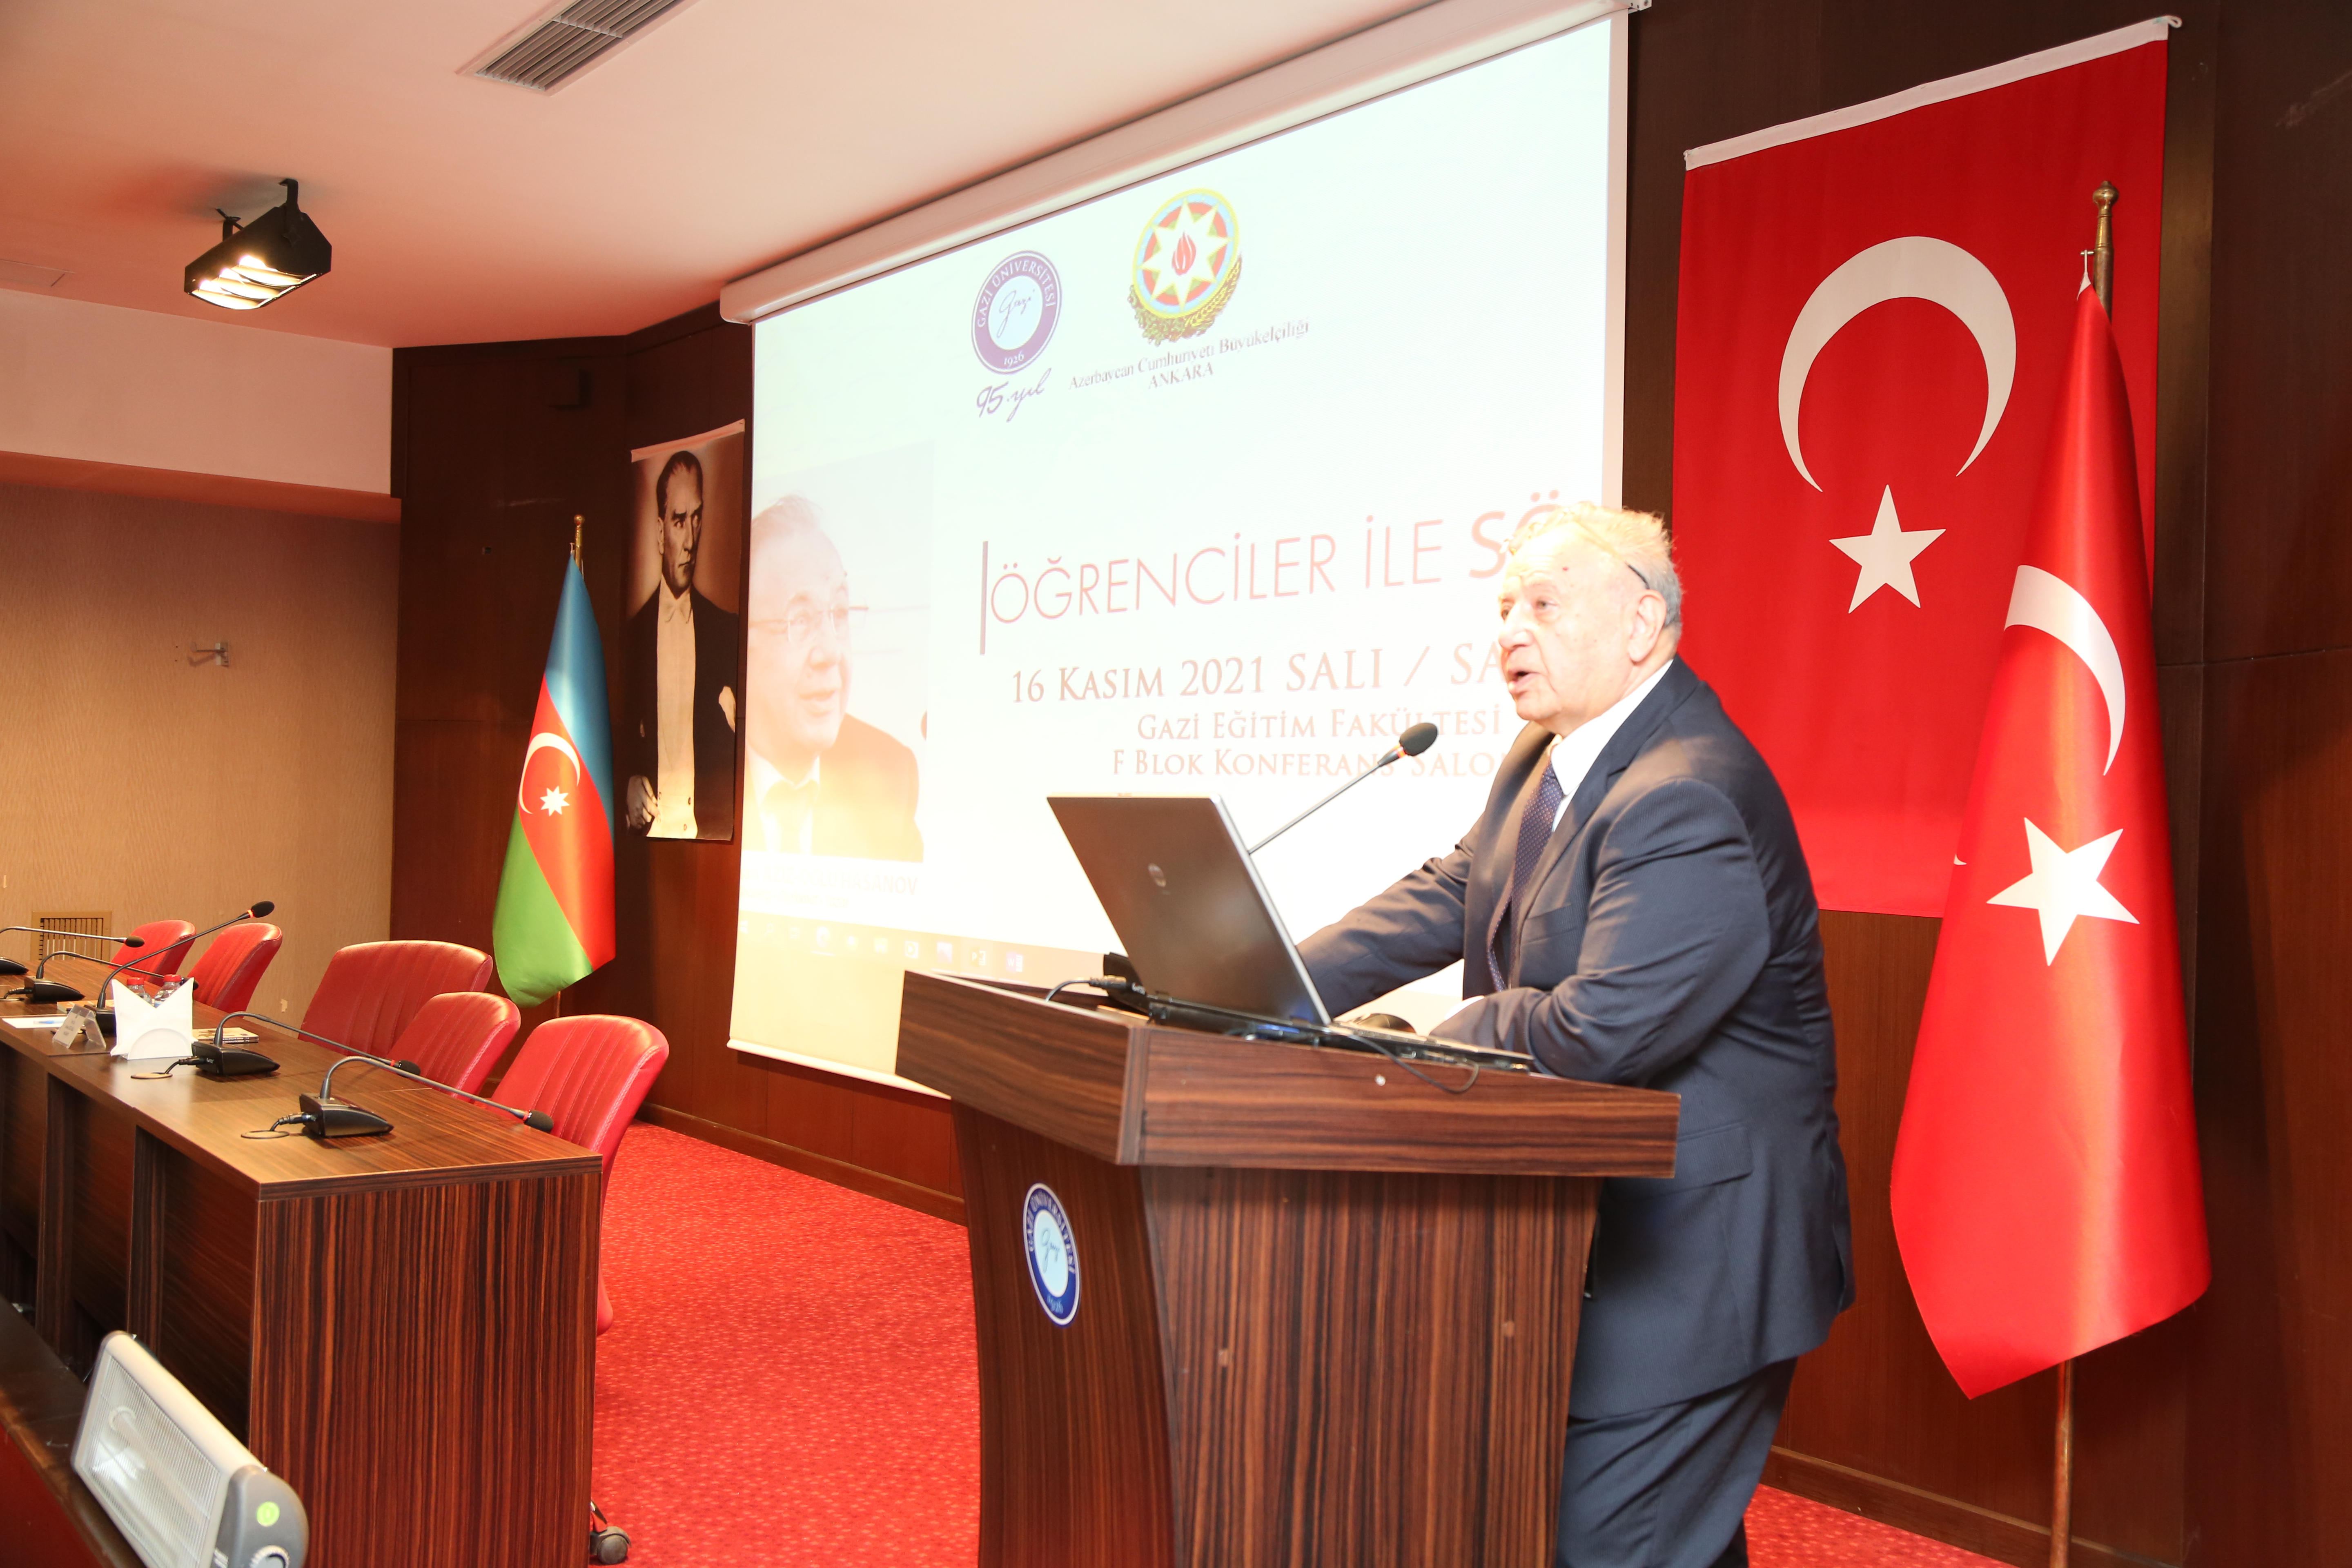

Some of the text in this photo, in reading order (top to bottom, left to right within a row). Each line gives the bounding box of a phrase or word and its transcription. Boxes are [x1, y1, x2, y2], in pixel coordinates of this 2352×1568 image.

[1004, 350, 1025, 368] 1926
[1068, 317, 1309, 390] Azerbaycan Cumhuriyeti Büyükelçiliği
[1148, 361, 1214, 389] ANKARA
[991, 532, 1336, 624] ÖĞRENCİLER
[1365, 514, 1443, 589] İLE
[1012, 668, 1045, 703] 16
[1058, 666, 1164, 701] KASIM
[1180, 655, 1264, 696] 2021
[1286, 648, 1383, 692] SALI
[1403, 645, 1430, 686] /
[1137, 713, 1200, 739] GAZİ
[1213, 710, 1316, 738] EĞİTİM
[1113, 749, 1125, 775] F
[1135, 748, 1204, 775] BLOK
[1411, 752, 1507, 776] SALO
[841, 871, 918, 895] HASANOV
